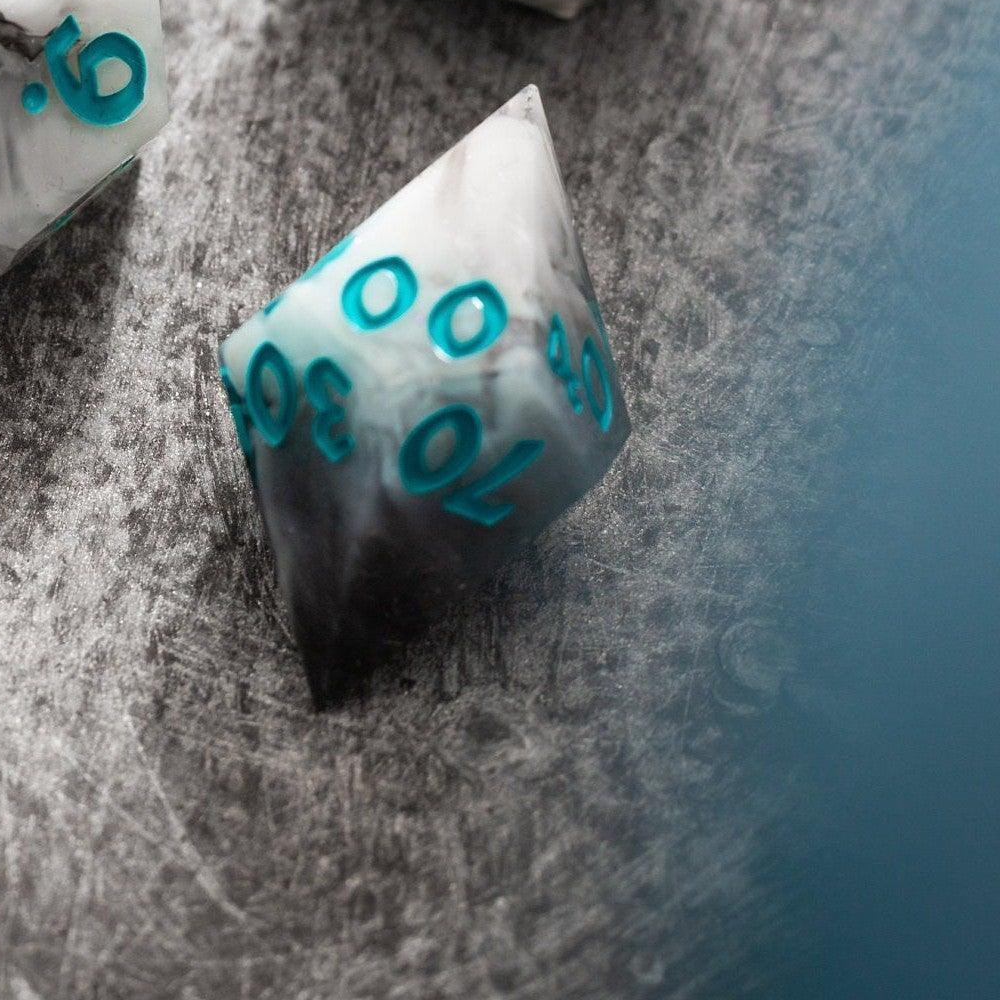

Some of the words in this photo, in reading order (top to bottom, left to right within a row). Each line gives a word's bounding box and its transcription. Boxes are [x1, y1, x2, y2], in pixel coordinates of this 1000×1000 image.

[340, 255, 509, 360] 00
[245, 340, 355, 463] 30
[398, 402, 546, 527] 70
